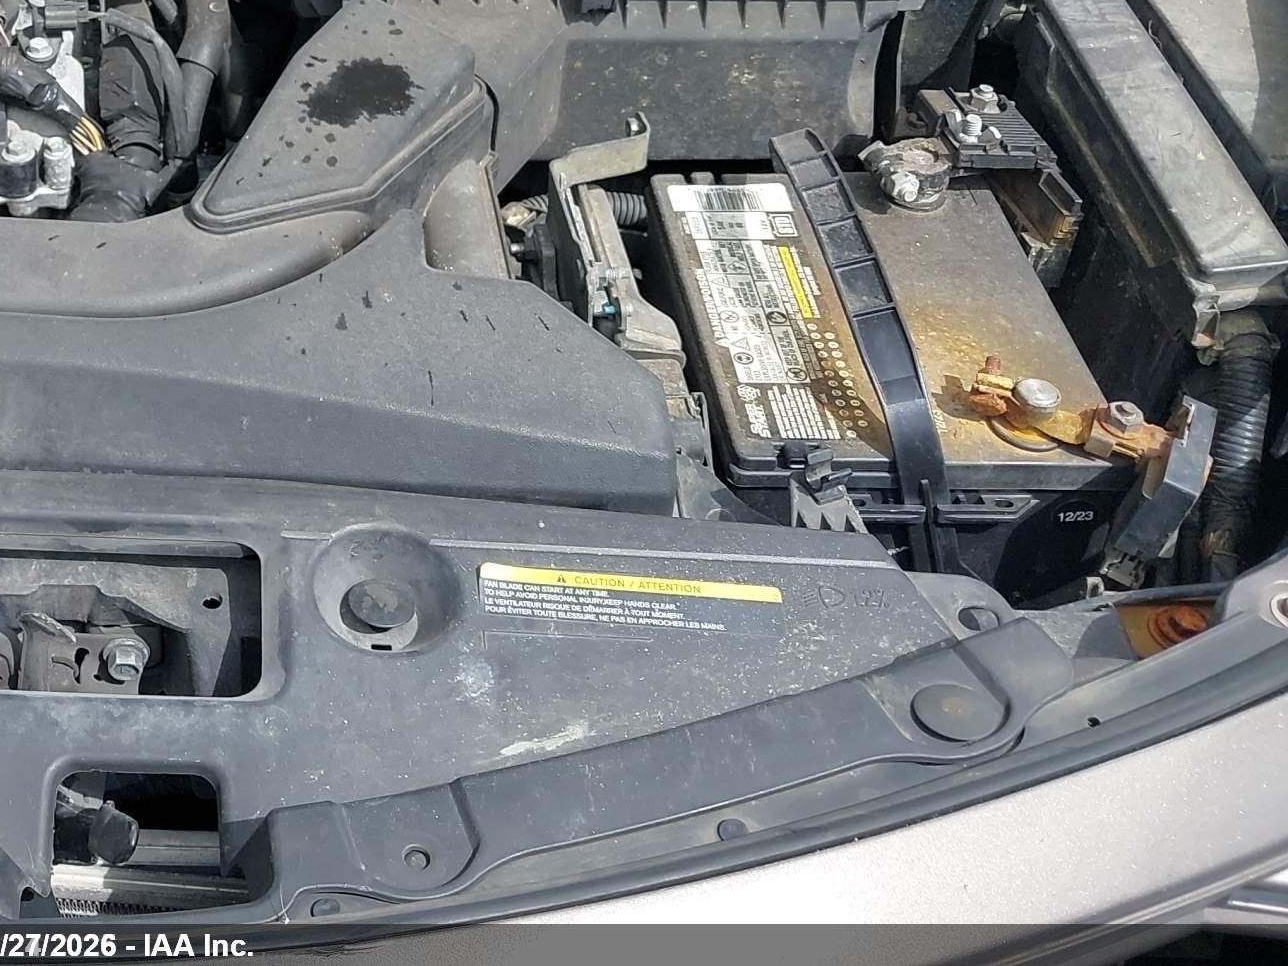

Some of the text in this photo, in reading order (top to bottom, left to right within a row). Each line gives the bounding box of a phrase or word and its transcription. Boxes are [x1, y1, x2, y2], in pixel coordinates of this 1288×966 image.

[1057, 510, 1094, 523] 12/23
[499, 581, 523, 591] BLADE
[524, 583, 540, 592] CAN
[542, 585, 564, 594] START
[575, 588, 589, 596] ANY
[574, 576, 625, 587] CAUTION
[639, 581, 701, 593] ATTENTION
[496, 589, 515, 597] HELP
[516, 591, 537, 599] AVOID
[539, 593, 577, 603] PERSONAL
[494, 599, 542, 609] VENTILATEUR
[543, 602, 570, 611] RISQUE
[485, 605, 506, 613] POUR
[533, 609, 557, 618] TOUTE
[599, 614, 609, 622] NE
[611, 615, 625, 623] PAS
[638, 617, 685, 627] APPROCHER
